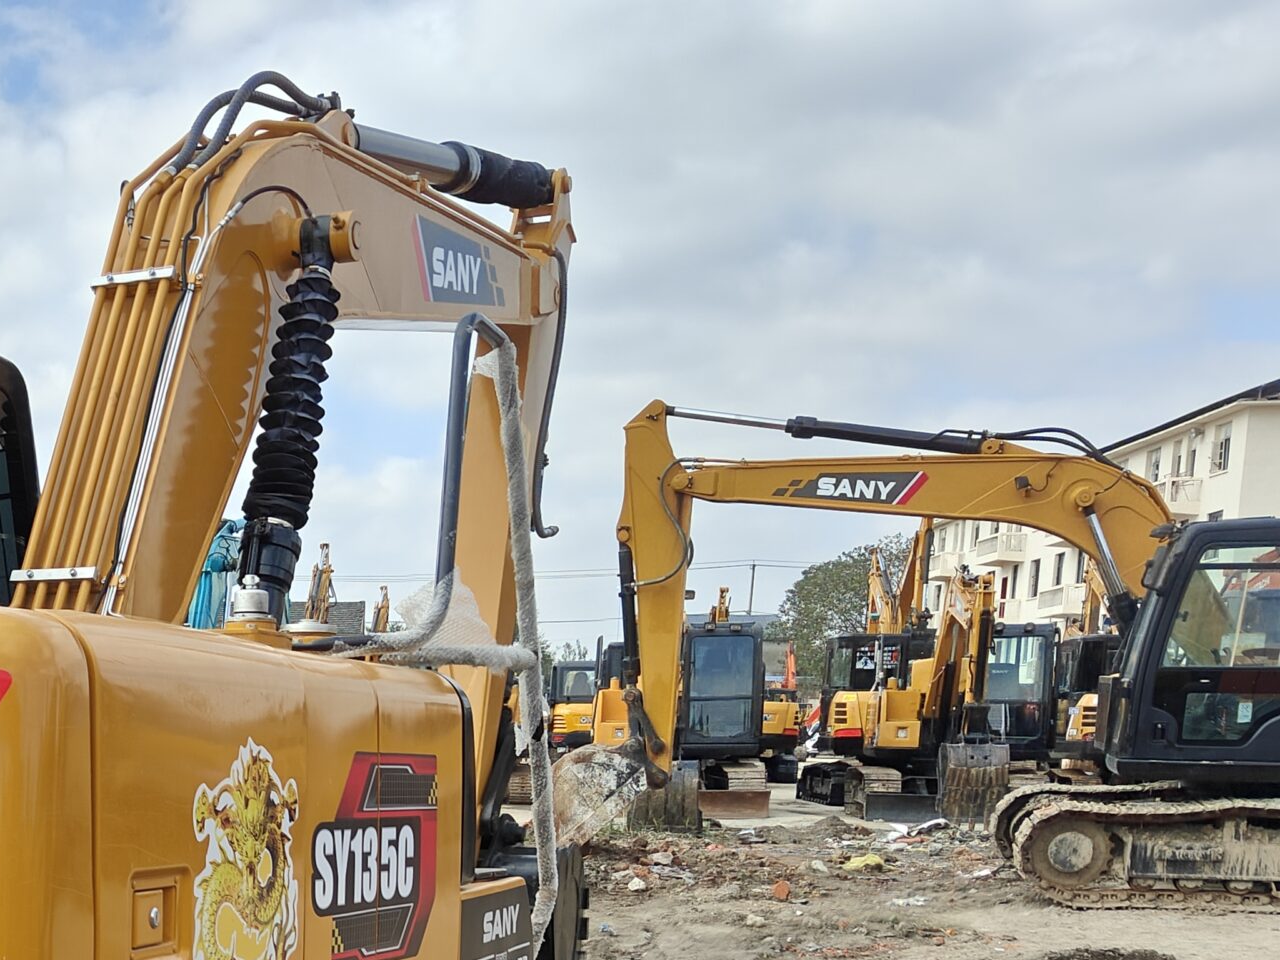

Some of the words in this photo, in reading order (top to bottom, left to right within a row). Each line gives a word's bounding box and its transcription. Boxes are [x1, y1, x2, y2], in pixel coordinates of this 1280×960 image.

[432, 246, 481, 295] SANY
[816, 477, 896, 500] SANY
[315, 824, 414, 910] SY135C
[483, 903, 520, 944] SANY
